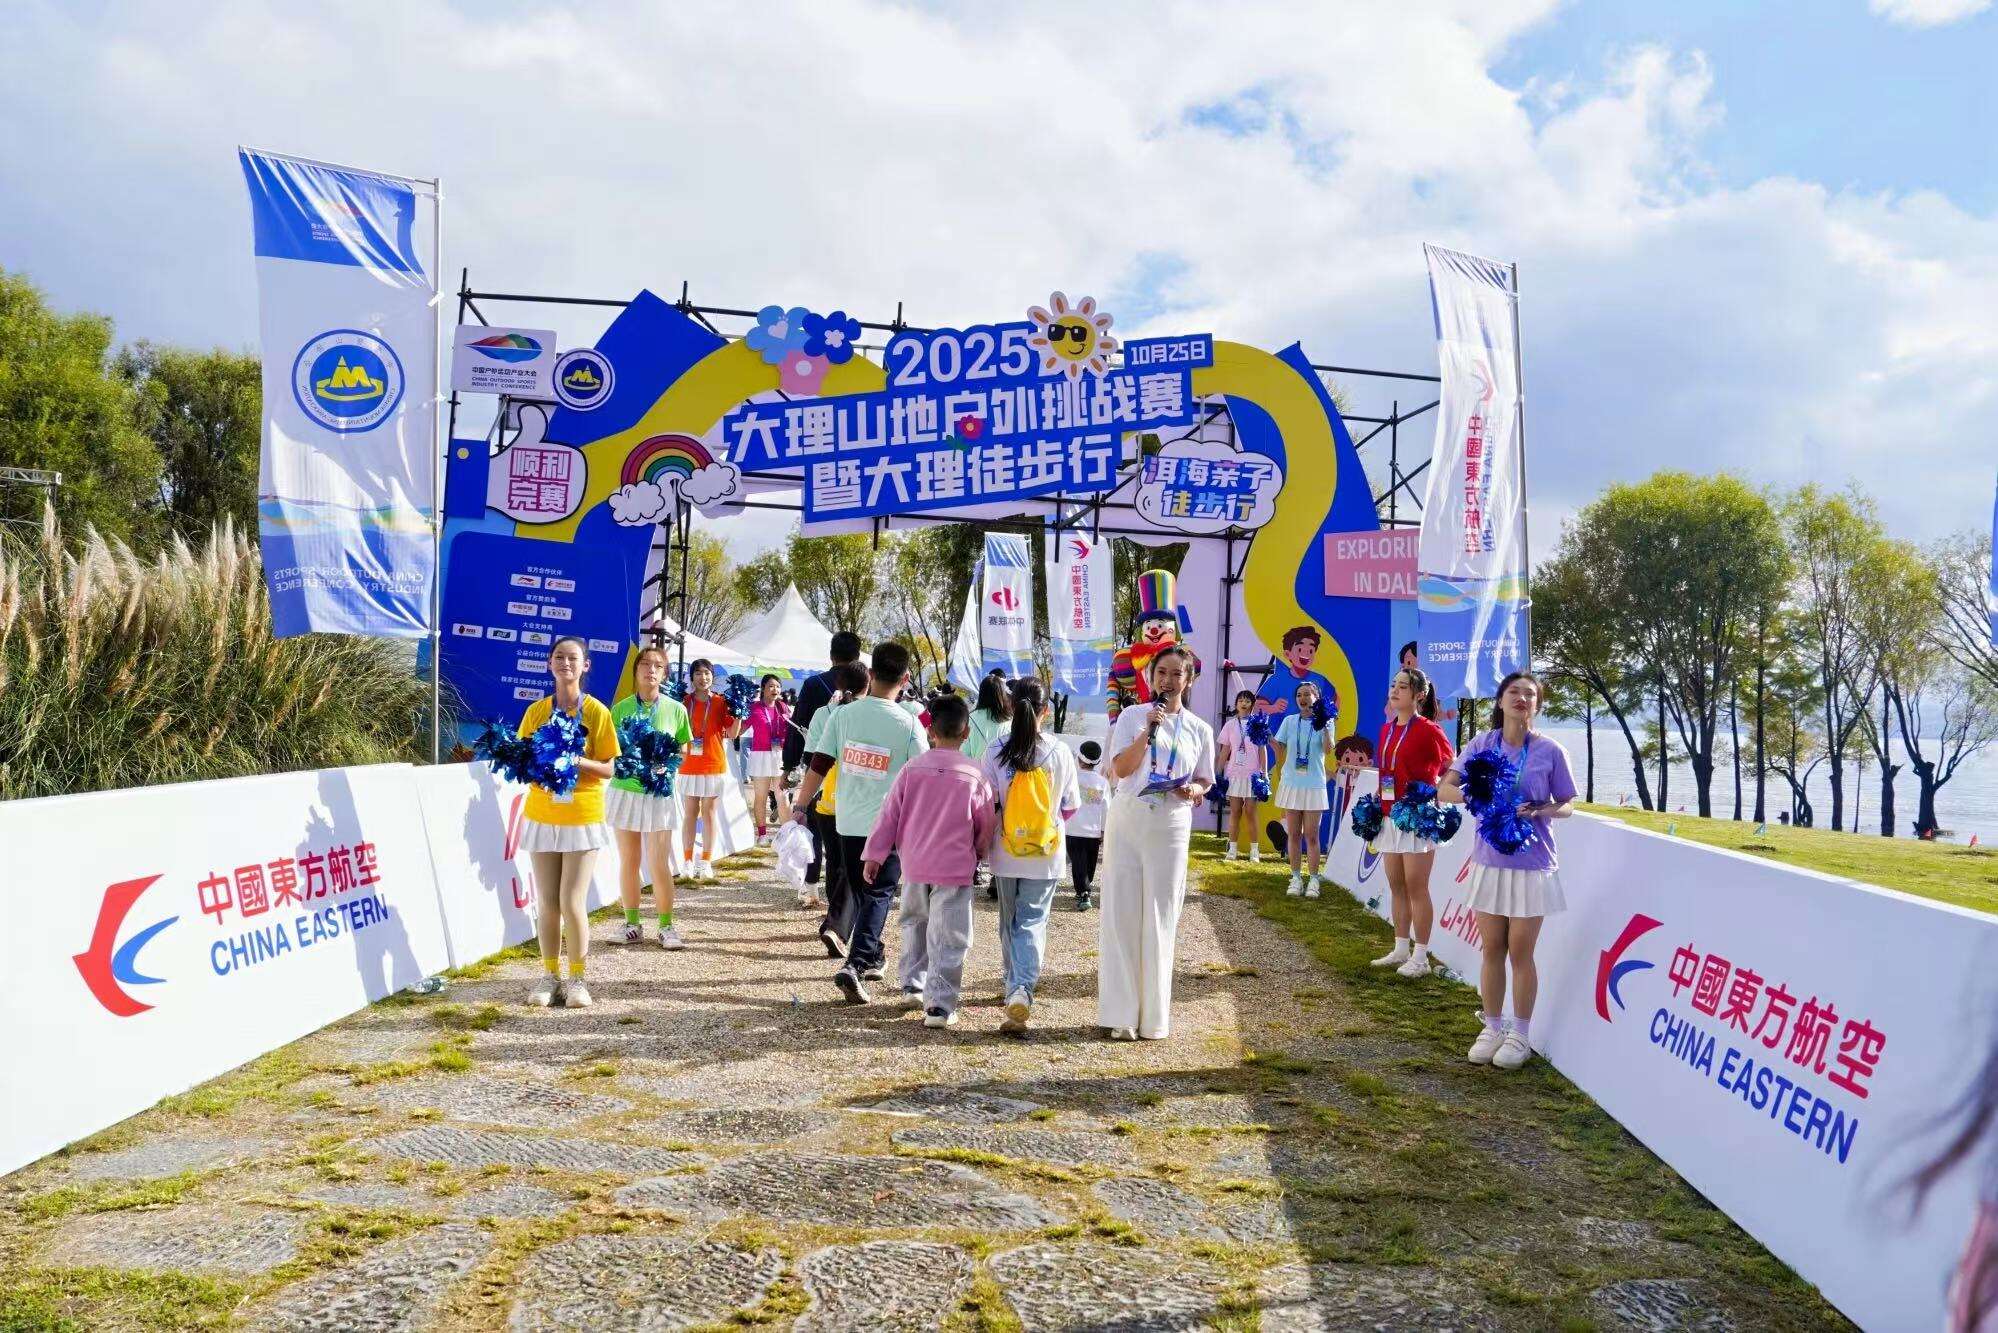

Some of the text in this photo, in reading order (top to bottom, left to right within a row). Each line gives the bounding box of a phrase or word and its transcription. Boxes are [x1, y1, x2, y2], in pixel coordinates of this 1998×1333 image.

[892, 328, 1031, 386] 2025
[1131, 340, 1206, 365] 10月25日
[730, 372, 1184, 463] 大理山地户外挑战赛
[510, 447, 571, 481] 顺利
[811, 434, 1113, 514] 暨大理徒步行
[1144, 456, 1273, 490] 洱海亲子
[508, 479, 570, 514] 完赛
[1162, 489, 1256, 521] 徒步行
[1337, 536, 1419, 560] EXPLORI
[1354, 571, 1372, 593] IN
[197, 840, 381, 926] 中國東方航空
[210, 893, 389, 976] CHINA EASTERN
[1668, 942, 1886, 1100] 中國東方航空
[1650, 1008, 1858, 1164] CHINA EASTERN
